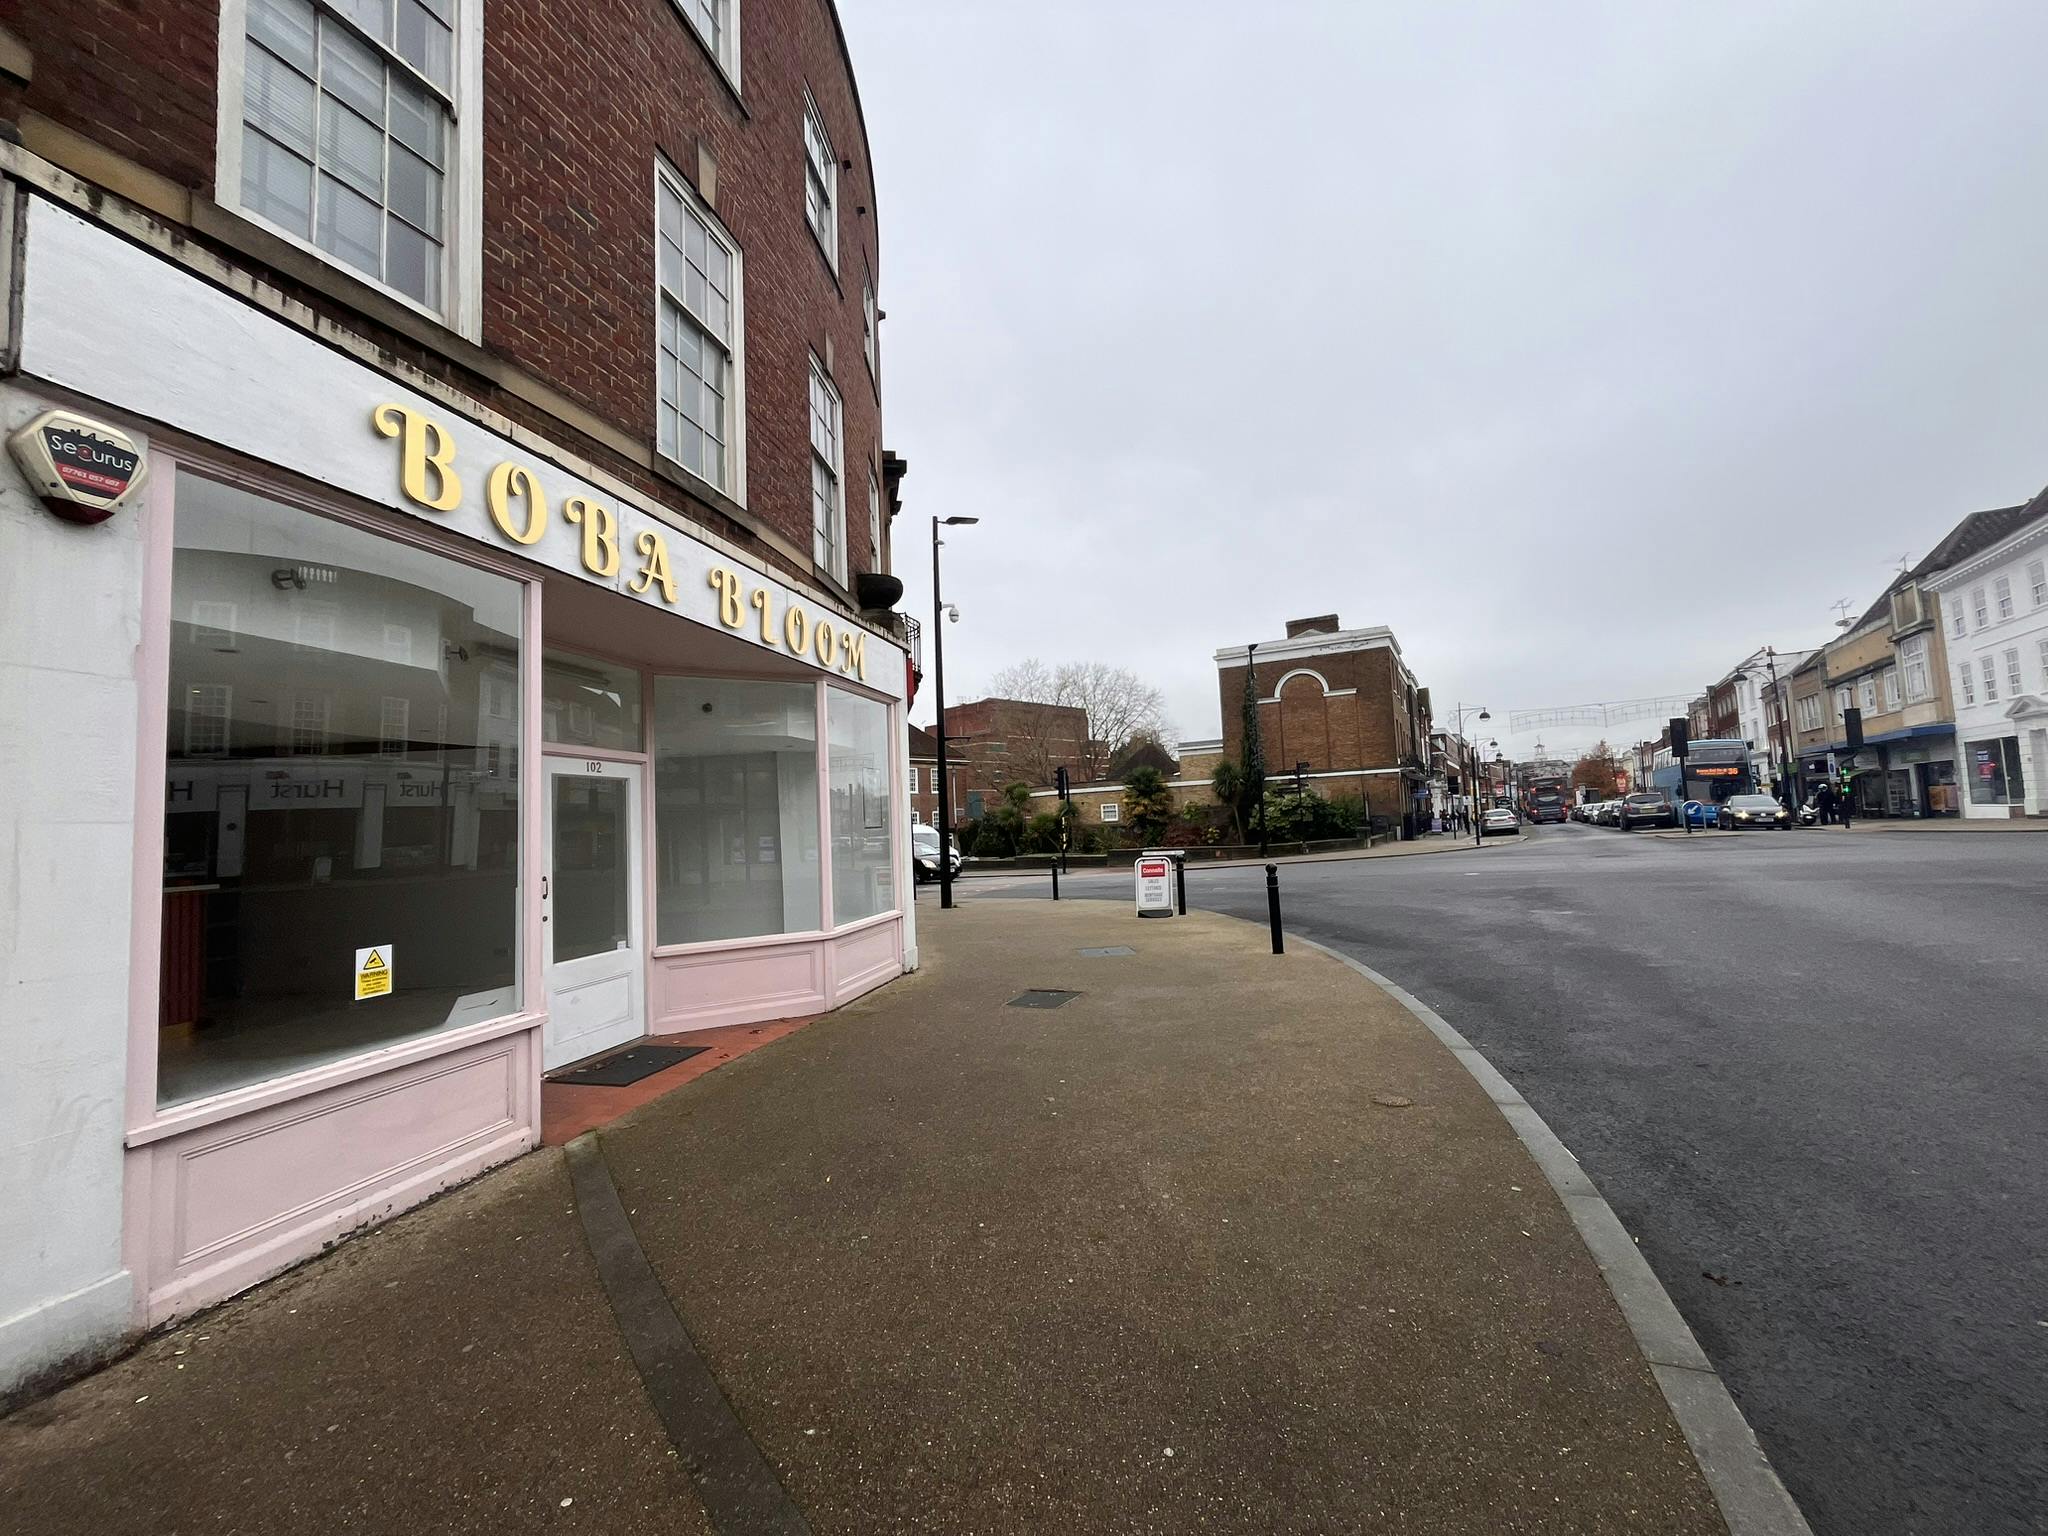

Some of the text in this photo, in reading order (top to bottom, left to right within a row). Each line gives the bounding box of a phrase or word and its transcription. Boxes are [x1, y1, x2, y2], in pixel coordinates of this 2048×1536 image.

[373, 402, 867, 681] BOBA BLOOM
[586, 761, 602, 773] 102
[360, 969, 388, 980] WARNING
